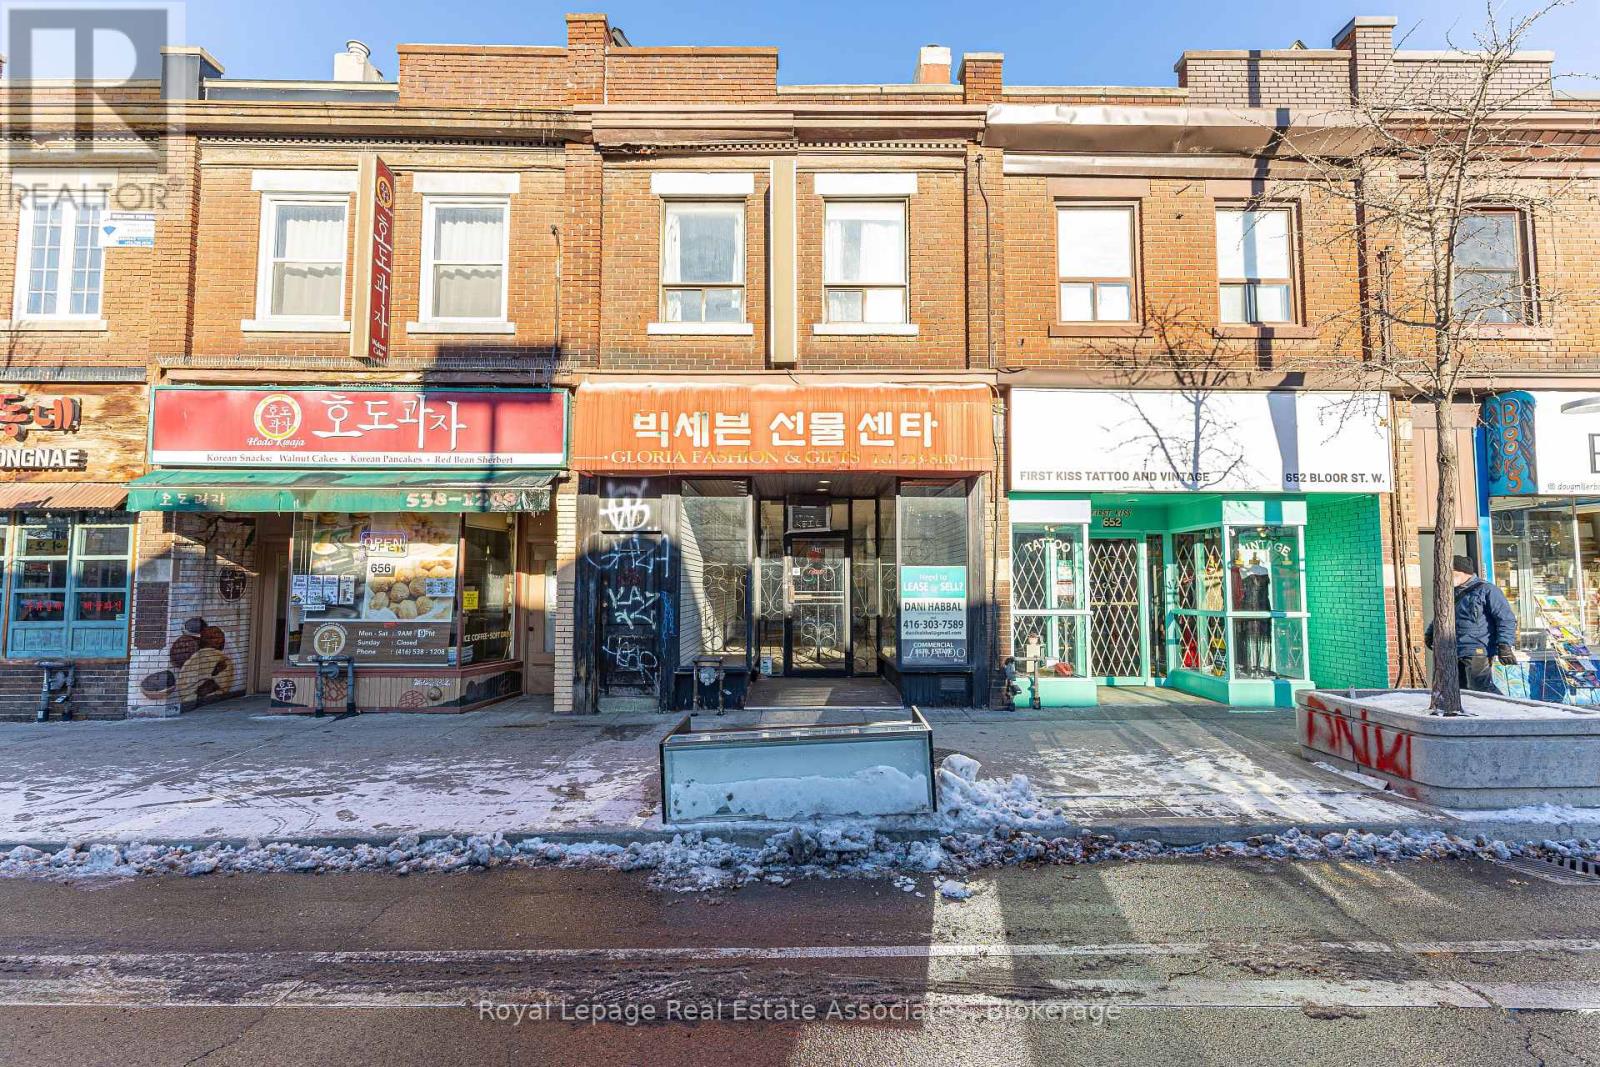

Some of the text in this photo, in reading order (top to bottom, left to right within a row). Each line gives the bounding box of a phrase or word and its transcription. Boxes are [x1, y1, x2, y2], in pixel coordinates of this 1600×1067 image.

[311, 393, 468, 451] 호도과자
[632, 411, 939, 448] 빅세븐 선물 센타
[207, 454, 237, 463] Korean
[240, 454, 272, 463] Snacks:
[279, 454, 309, 463] Walnut
[312, 454, 338, 463] Cakes
[350, 455, 381, 464] Korean
[383, 455, 423, 464] Pancakes
[434, 455, 451, 464] Red
[454, 455, 475, 464] Bean
[477, 455, 513, 465] Sherbert
[611, 450, 685, 465] GLORIA
[692, 450, 779, 465] FASHION
[784, 451, 801, 464] &
[806, 450, 860, 465] GIFTS
[1020, 471, 1210, 482] FIRST KISS TATTOO AND VINTAGE
[1285, 473, 1386, 483] 652 BLOOR ST. W.
[1103, 517, 1122, 527] 652
[1025, 537, 1071, 554] TATTOO
[1240, 540, 1291, 557] INTAGE
[370, 564, 391, 573] 656
[903, 581, 929, 592] LEASE
[940, 581, 964, 592] SELL?
[904, 602, 963, 612] DANI HABBAL
[903, 620, 964, 630] 416-303-7589
[395, 648, 411, 656] (416)
